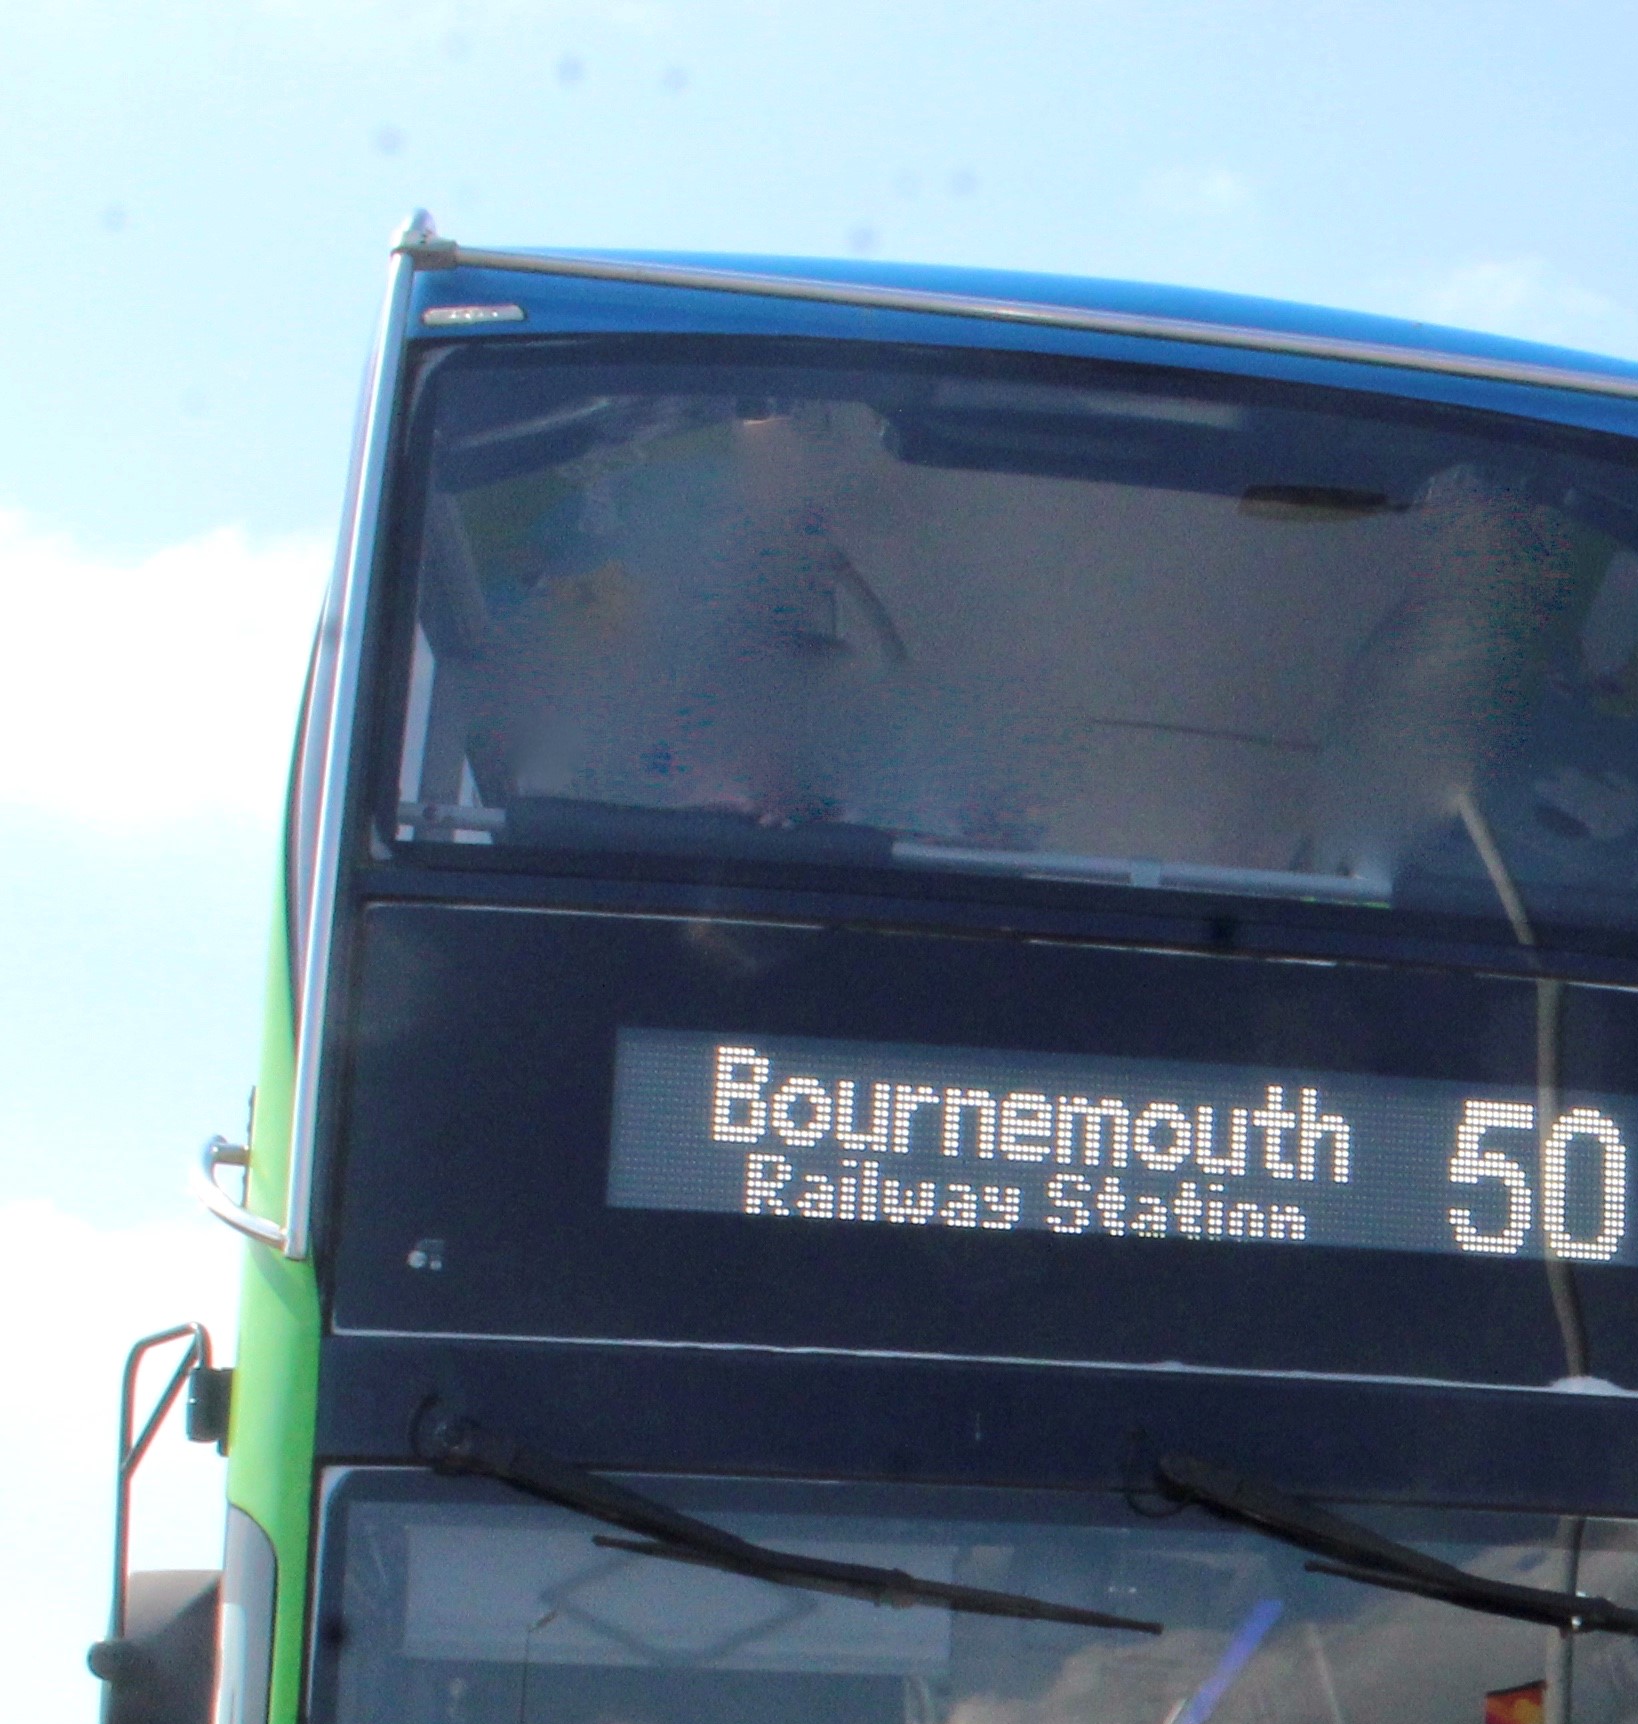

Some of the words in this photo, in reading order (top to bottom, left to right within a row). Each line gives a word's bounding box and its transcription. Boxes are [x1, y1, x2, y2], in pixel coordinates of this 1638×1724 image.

[711, 1046, 1350, 1183] Bournemouth
[1446, 1098, 1628, 1262] 50
[742, 1153, 1022, 1229] Railway
[1046, 1171, 1307, 1242] Station
